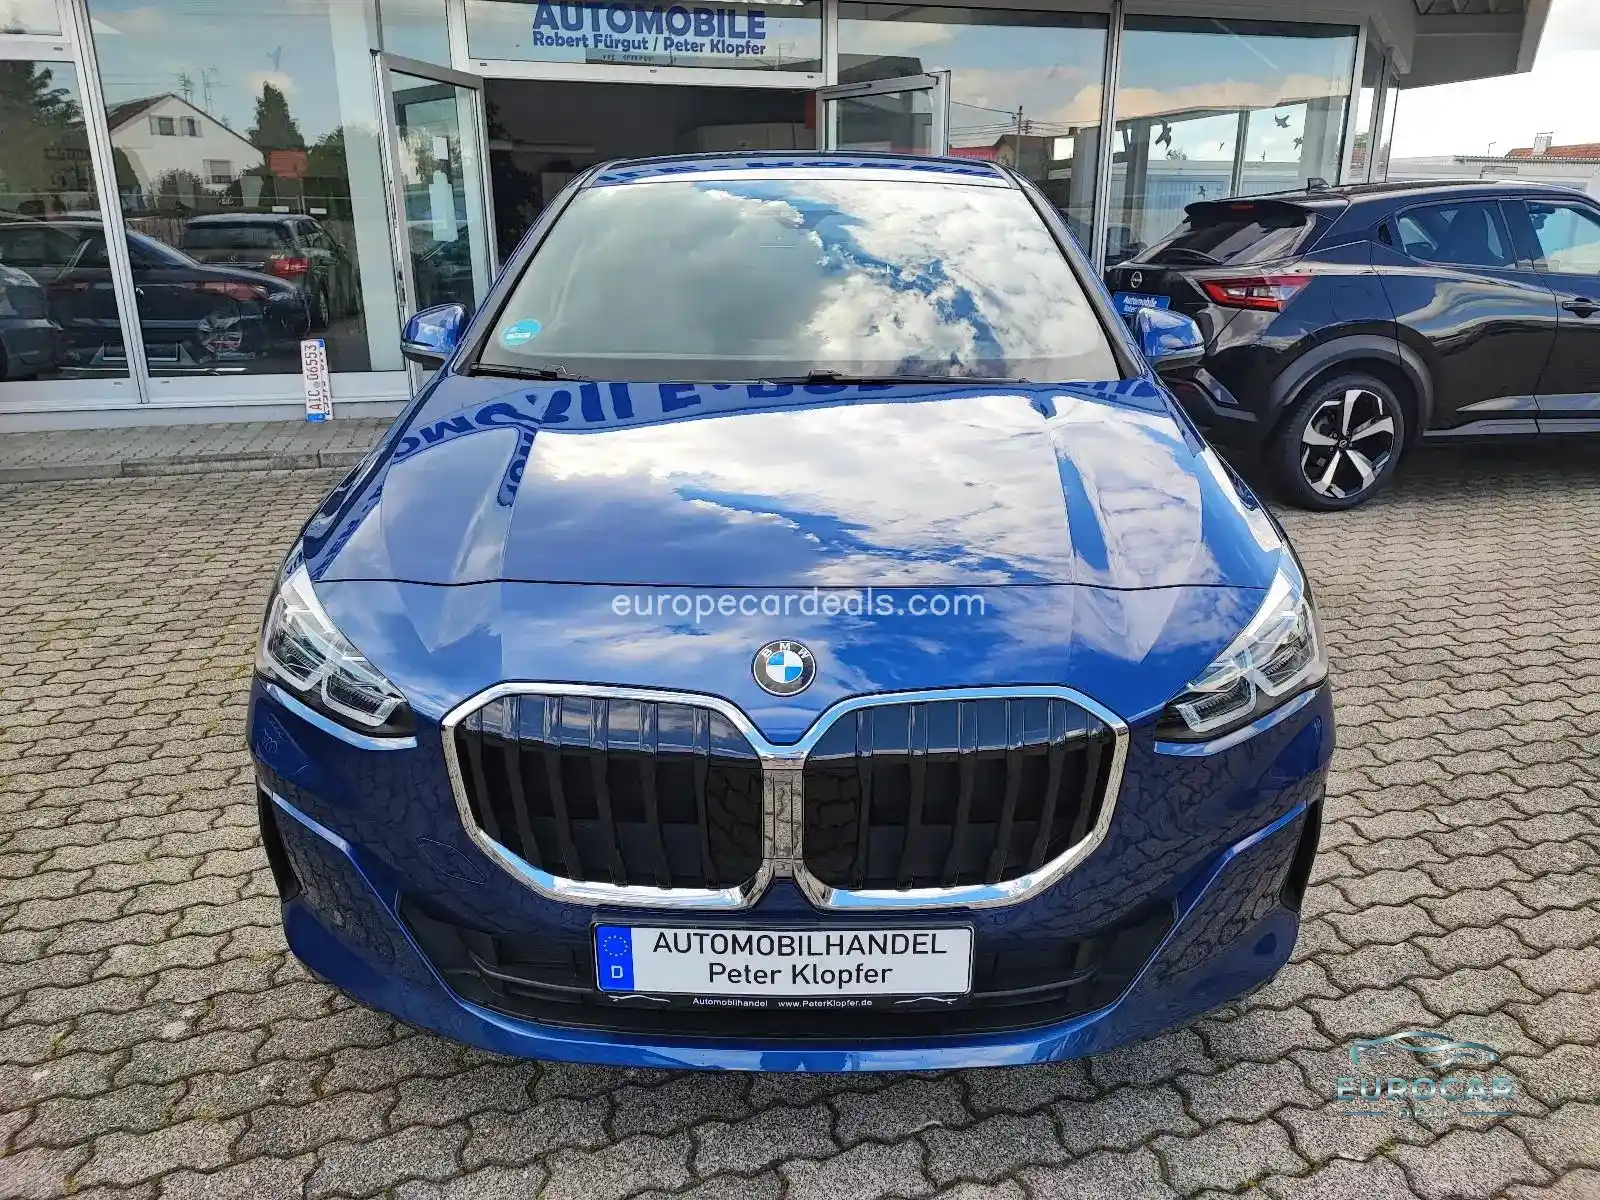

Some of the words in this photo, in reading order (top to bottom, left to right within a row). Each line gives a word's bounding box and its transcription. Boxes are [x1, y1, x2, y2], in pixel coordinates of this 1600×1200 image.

[533, 0, 766, 39] AUTOMOBILE
[533, 30, 589, 48] Robert
[594, 33, 649, 52] Fürgut
[653, 37, 659, 51] /
[664, 37, 706, 53] Peter
[710, 39, 766, 57] Klopfer
[760, 642, 810, 659] BMW
[652, 931, 947, 957] AUTOMOBILHANDEL
[611, 965, 624, 979] D
[709, 962, 782, 985] Peter
[791, 963, 893, 990] Klopfer
[692, 997, 768, 1007] Automobilhandel
[778, 998, 873, 1008] www.PeterKlopfer.de
